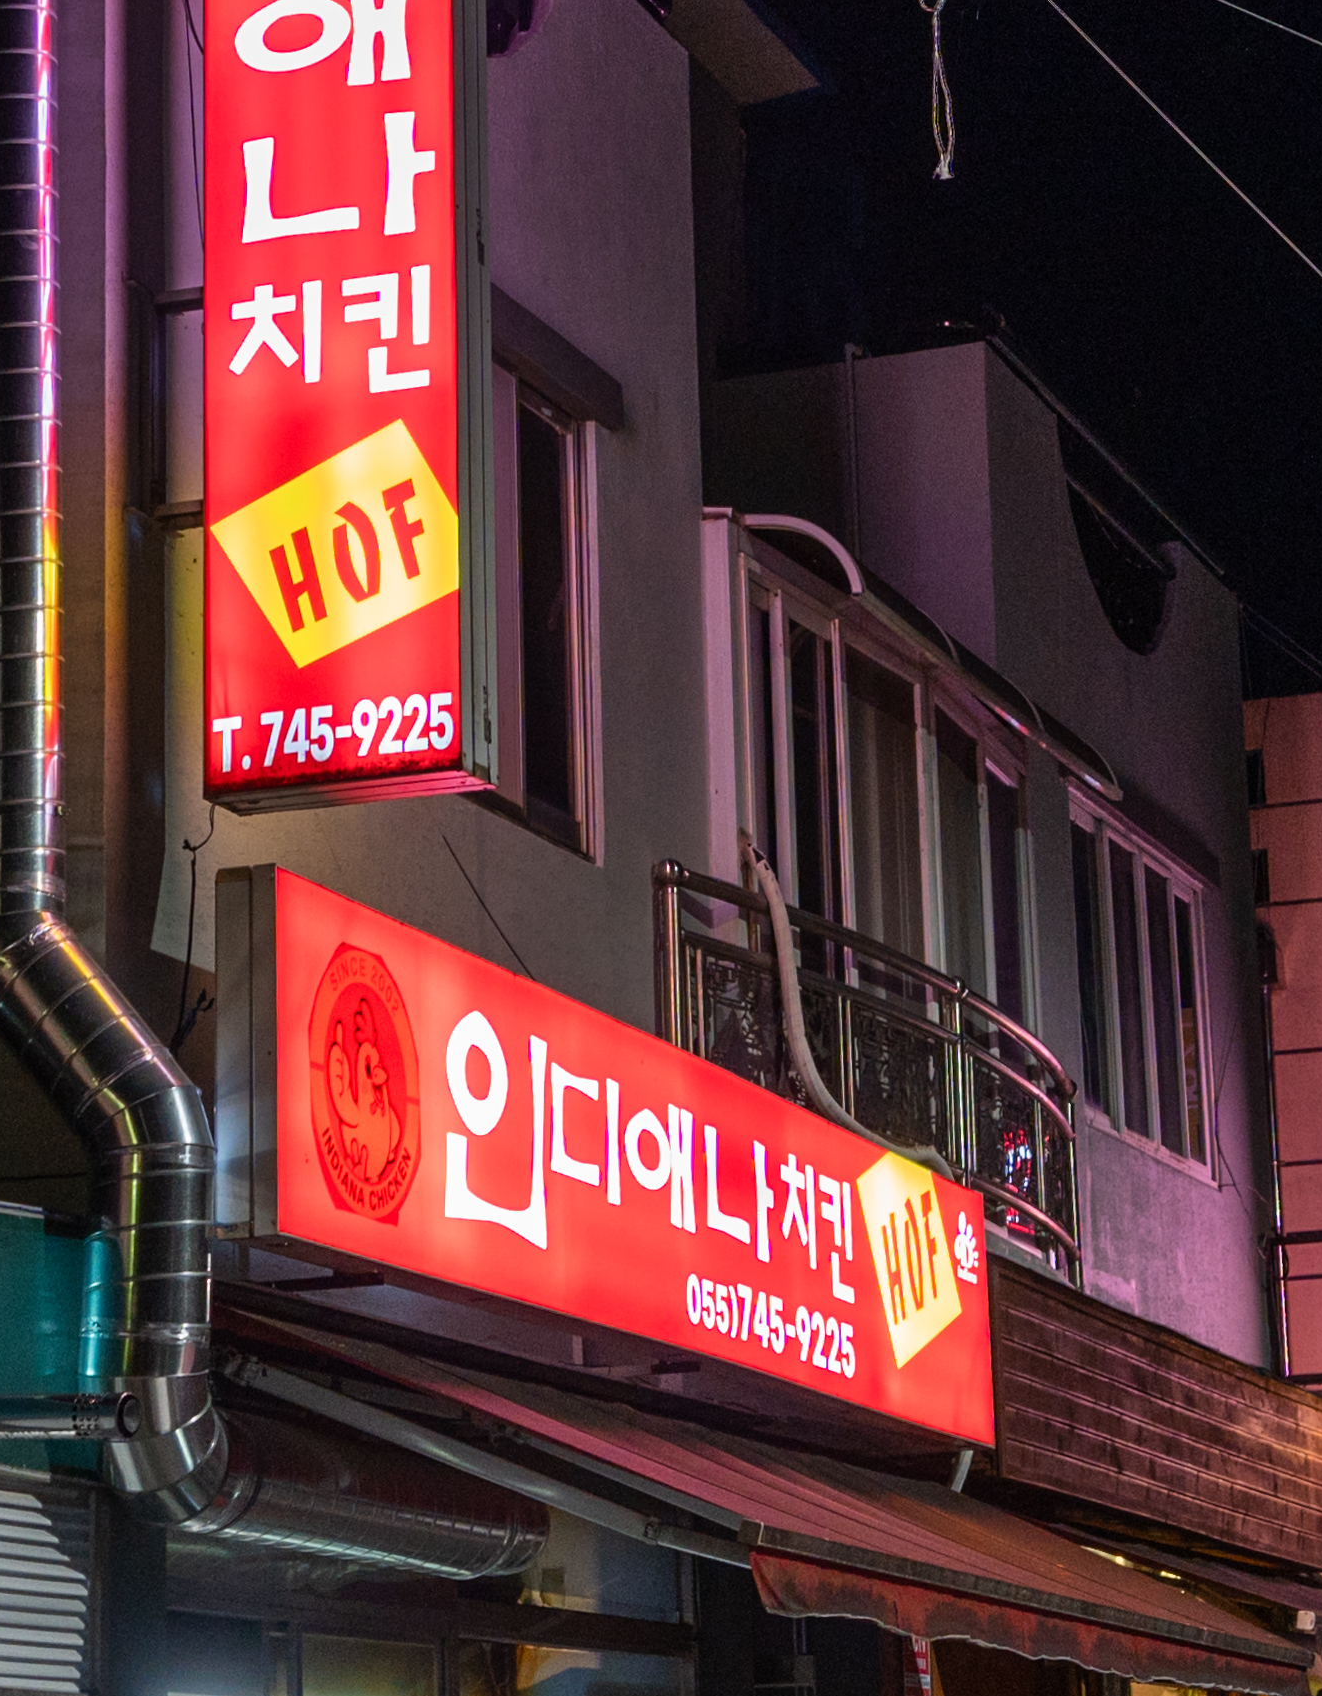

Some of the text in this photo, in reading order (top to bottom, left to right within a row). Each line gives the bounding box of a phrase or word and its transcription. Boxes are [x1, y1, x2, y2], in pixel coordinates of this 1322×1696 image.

[228, 265, 431, 393] 치킨
[270, 477, 424, 632] HOF
[330, 958, 399, 1014] SINCE 2002
[322, 1128, 411, 1211] INDIANA CHICKEN
[779, 1152, 855, 1304] 치킨
[880, 1188, 939, 1328] HOF
[687, 1273, 856, 1379] 055)745-9225
